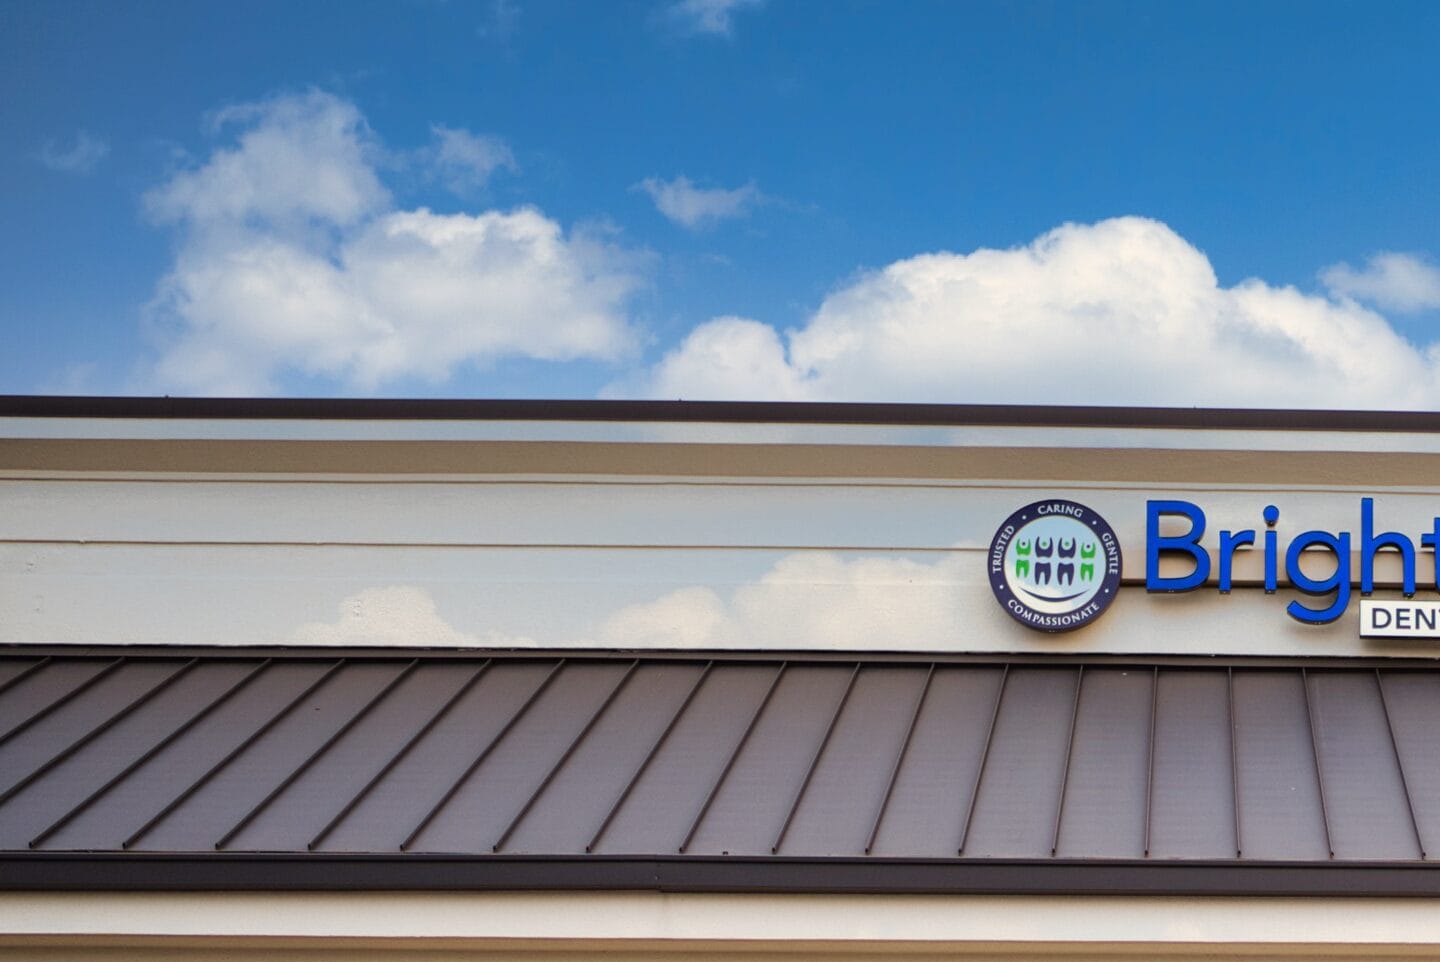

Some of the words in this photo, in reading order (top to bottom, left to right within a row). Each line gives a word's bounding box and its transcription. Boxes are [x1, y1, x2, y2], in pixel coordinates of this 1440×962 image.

[1037, 504, 1084, 517] CARING
[993, 525, 1015, 574] TRUSTED
[1101, 532, 1119, 575] GENTLE
[1007, 598, 1100, 626] COMPASSIONATE
